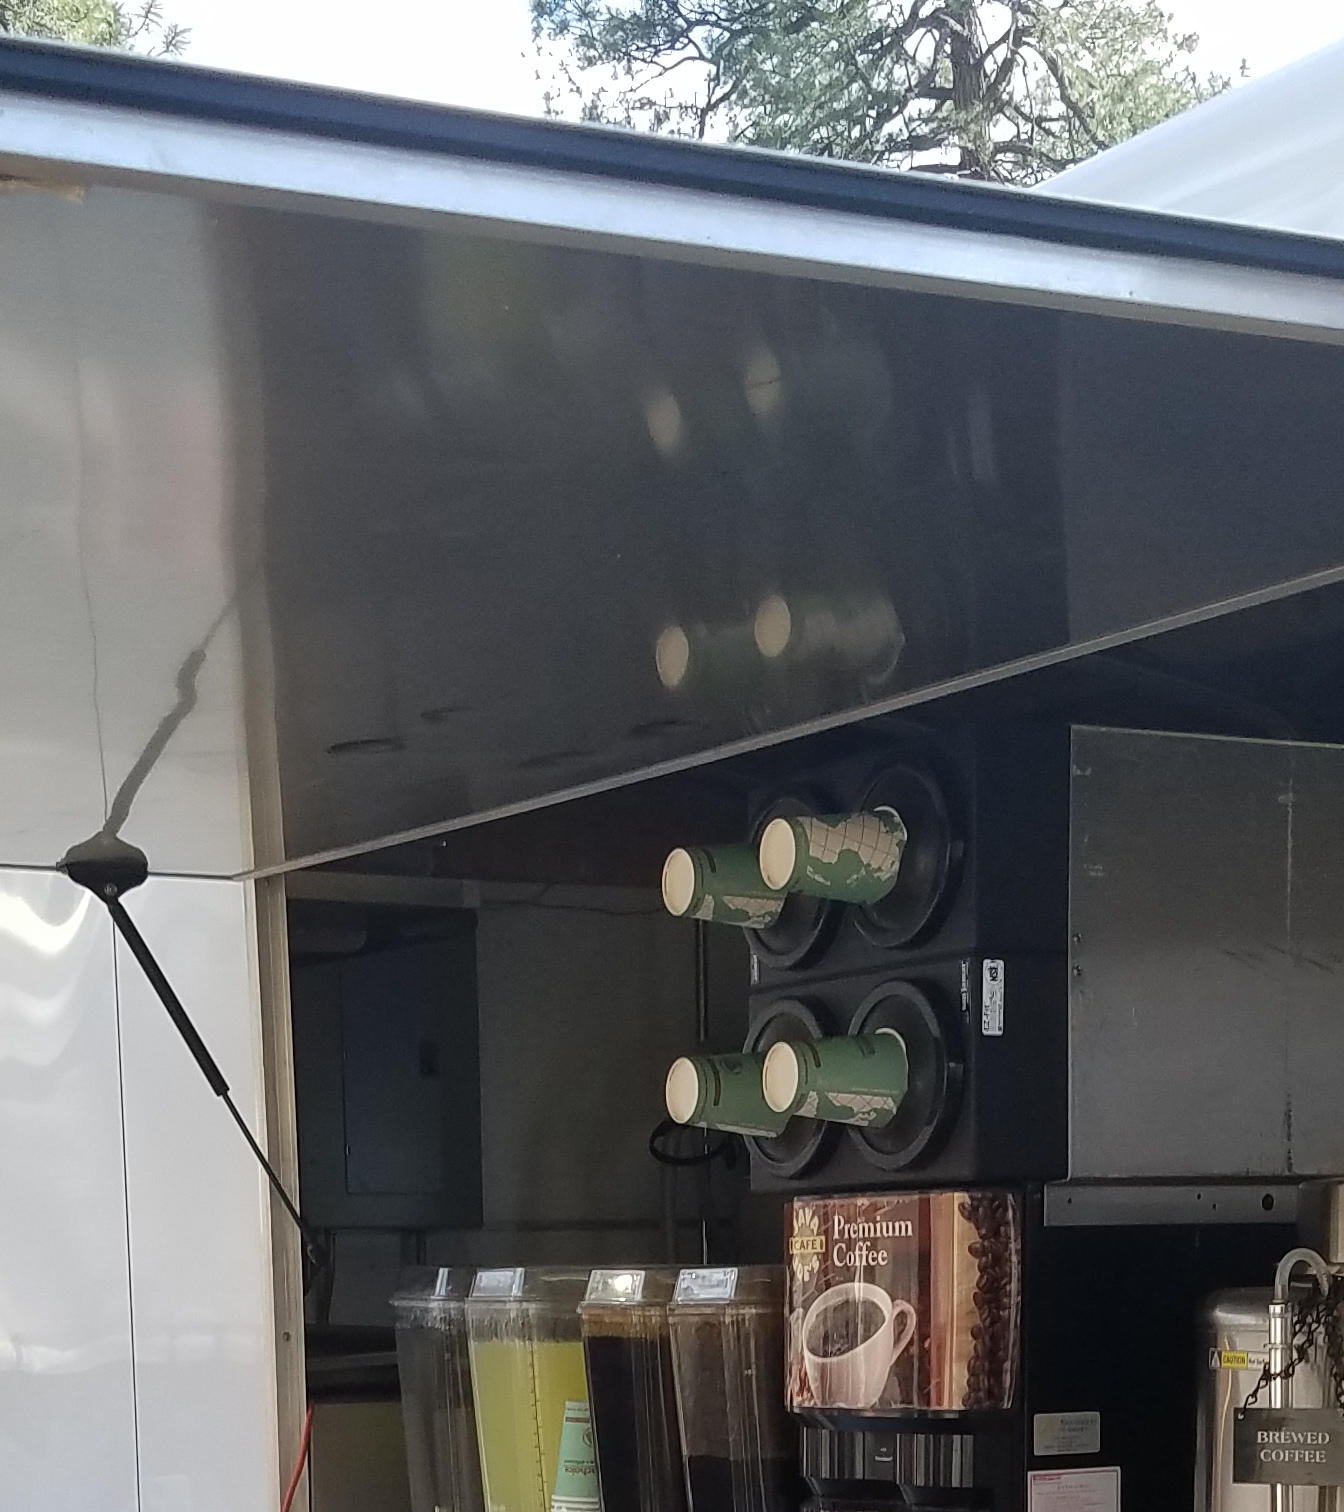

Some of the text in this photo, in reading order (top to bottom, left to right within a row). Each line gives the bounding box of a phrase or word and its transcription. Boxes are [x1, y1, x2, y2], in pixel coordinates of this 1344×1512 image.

[833, 1215, 913, 1240] Premium
[794, 1239, 817, 1251] CAFE
[833, 1241, 888, 1267] Coffee
[1257, 1431, 1330, 1445] BREWED
[1260, 1449, 1327, 1463] COFFEE
